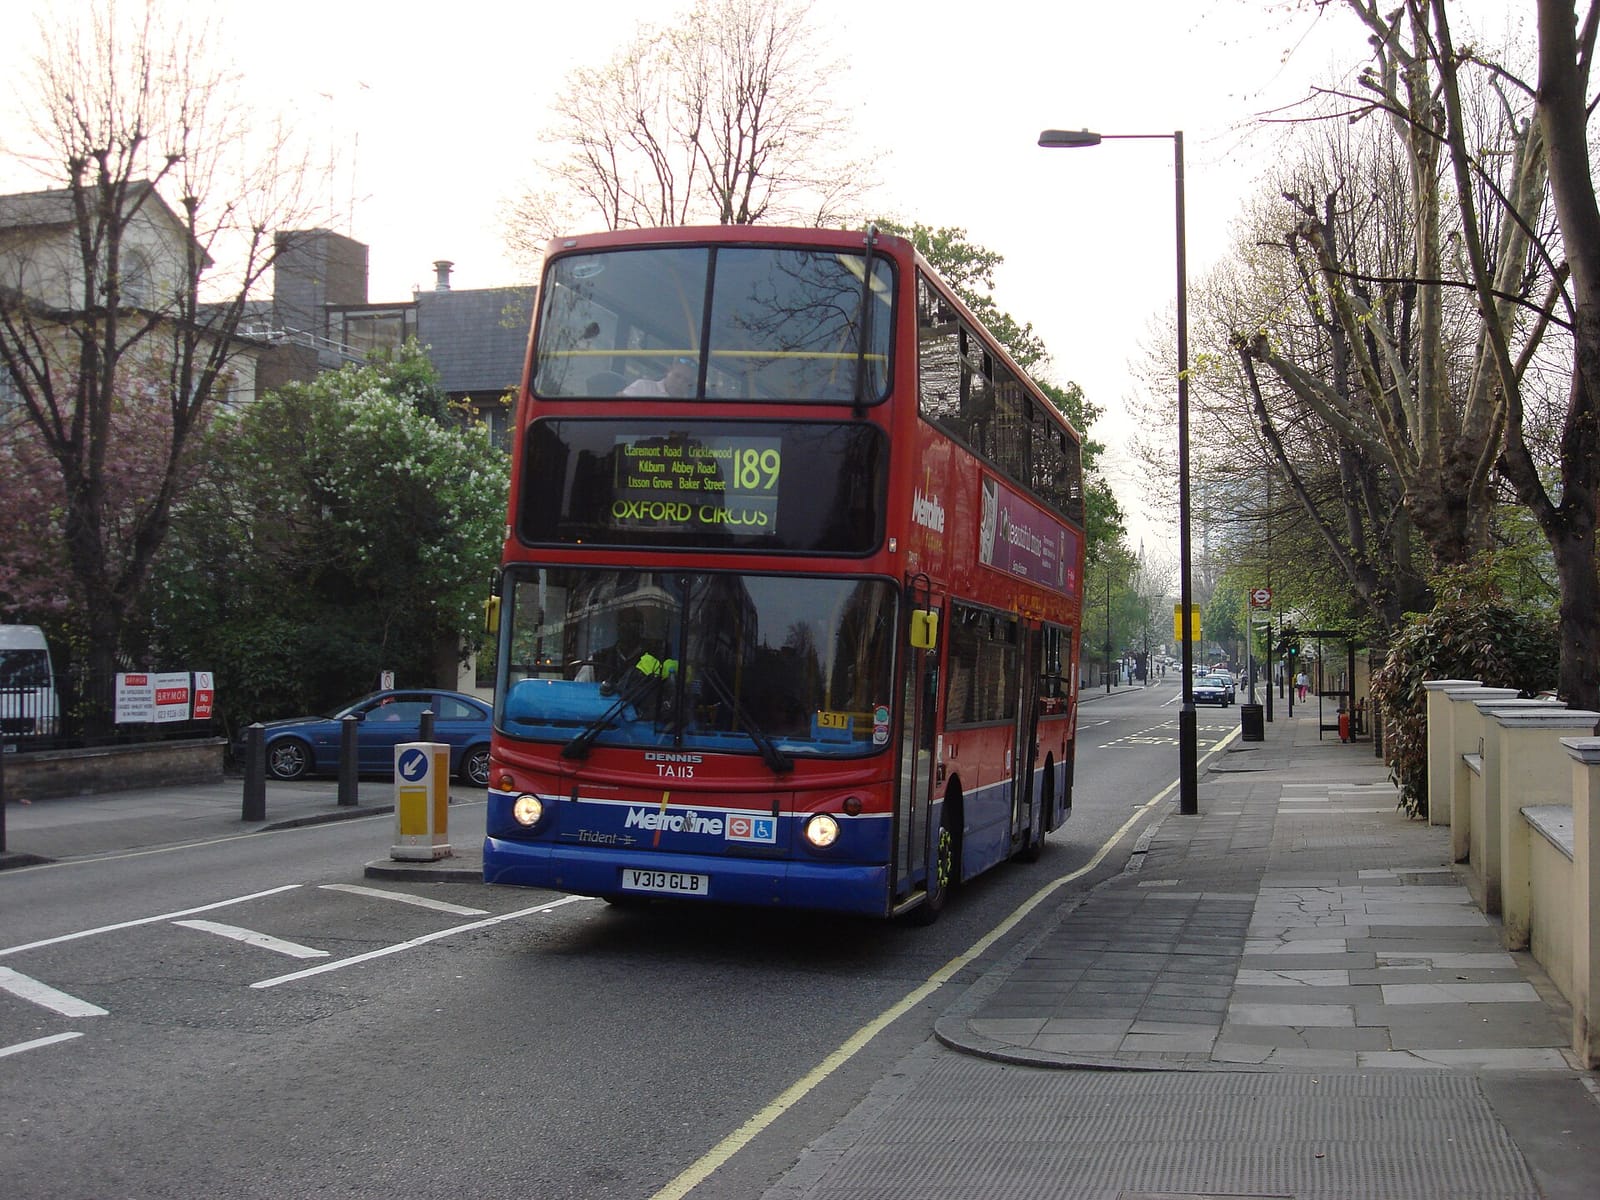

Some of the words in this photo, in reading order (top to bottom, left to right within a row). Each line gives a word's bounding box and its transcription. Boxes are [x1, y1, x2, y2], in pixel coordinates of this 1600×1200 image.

[624, 445, 660, 457] Claremont
[663, 446, 682, 458] Road
[688, 445, 733, 459] Cricklewood
[638, 460, 665, 473] Kilburn
[671, 461, 695, 477] Abbey
[697, 462, 717, 474] Road
[733, 448, 782, 490] 189
[628, 476, 650, 488] Lisson
[652, 477, 673, 489] Grove
[679, 477, 700, 490] Baker
[703, 478, 727, 491] Street
[612, 499, 692, 522] OXFORD
[698, 505, 769, 527] CIRCUS
[157, 690, 186, 702] BRYMOR
[822, 713, 846, 726] 511
[644, 752, 703, 764] DENNIS
[624, 807, 724, 836] Metroline
[578, 829, 618, 844] Trident
[632, 871, 666, 889] V313
[669, 873, 699, 892] GLB
